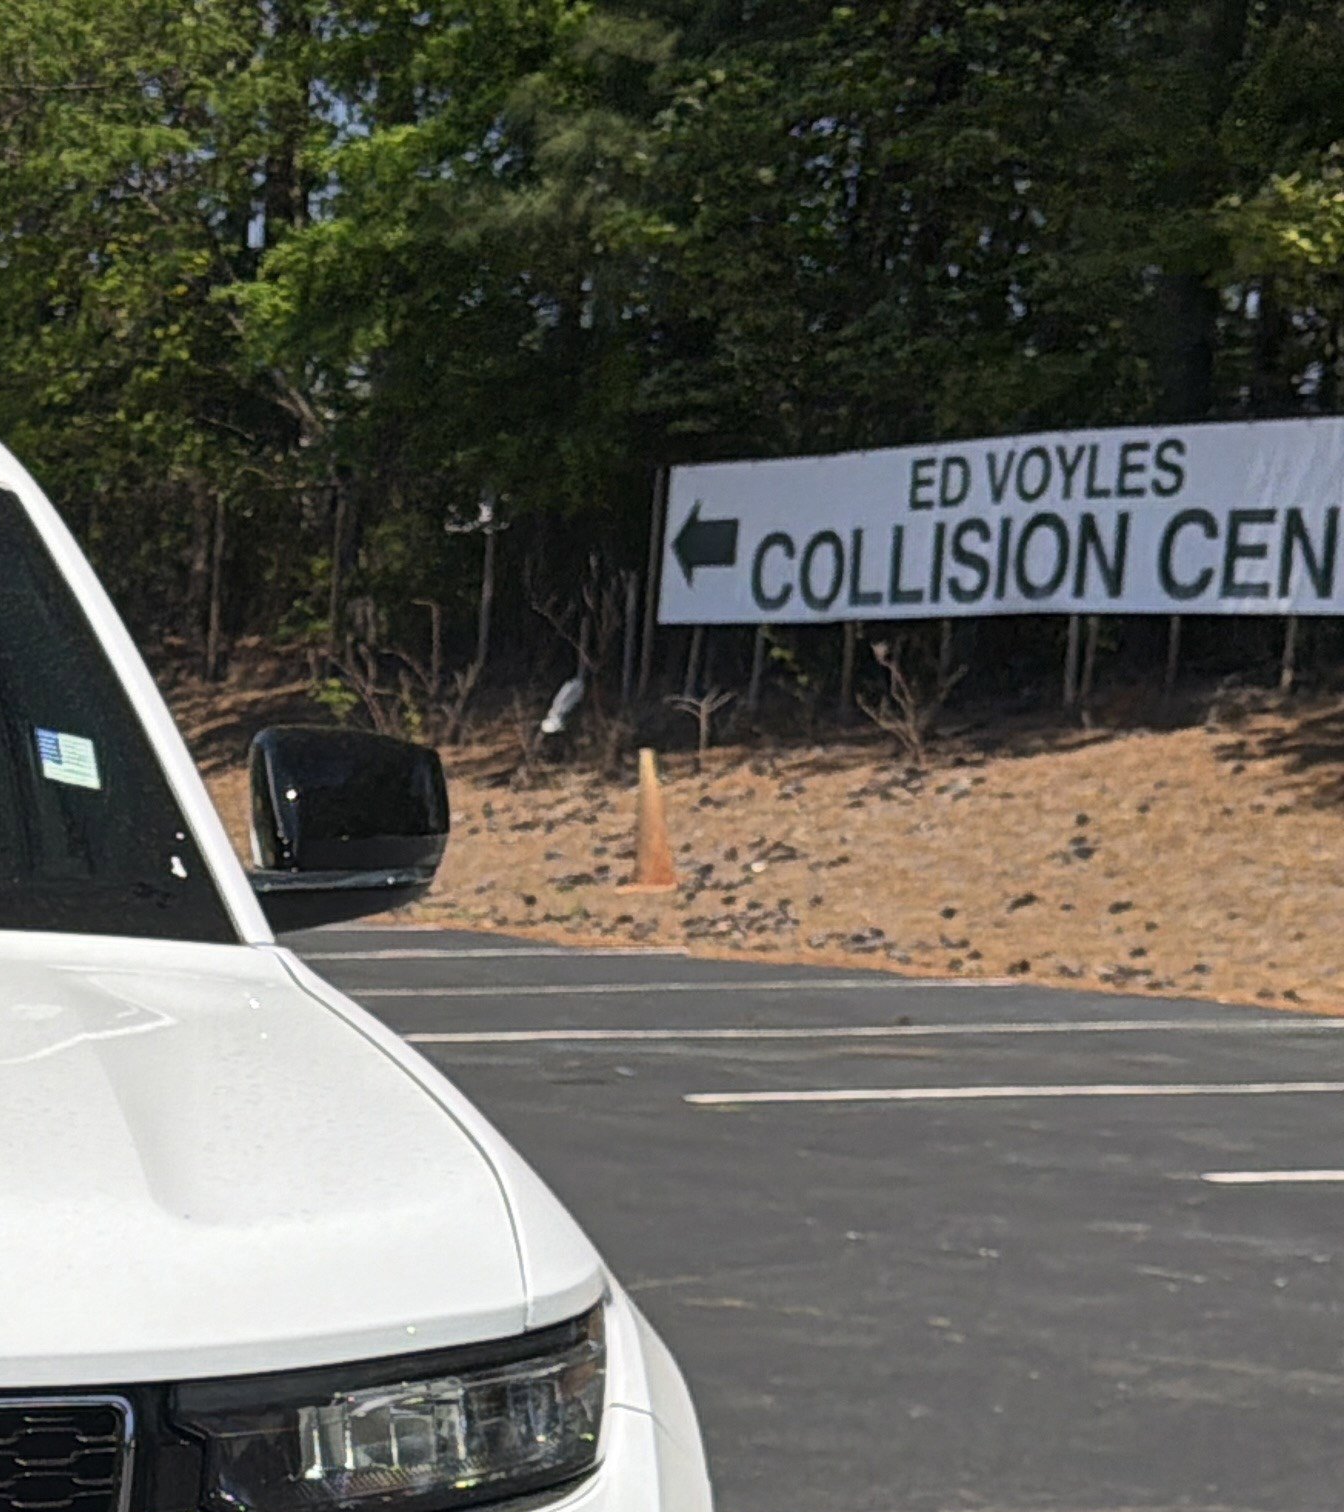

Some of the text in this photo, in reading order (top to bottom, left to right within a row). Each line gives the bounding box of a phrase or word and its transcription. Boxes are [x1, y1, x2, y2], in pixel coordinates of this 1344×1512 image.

[909, 438, 1187, 511] ED VOYLES
[751, 506, 1341, 613] COLLISION CEN
